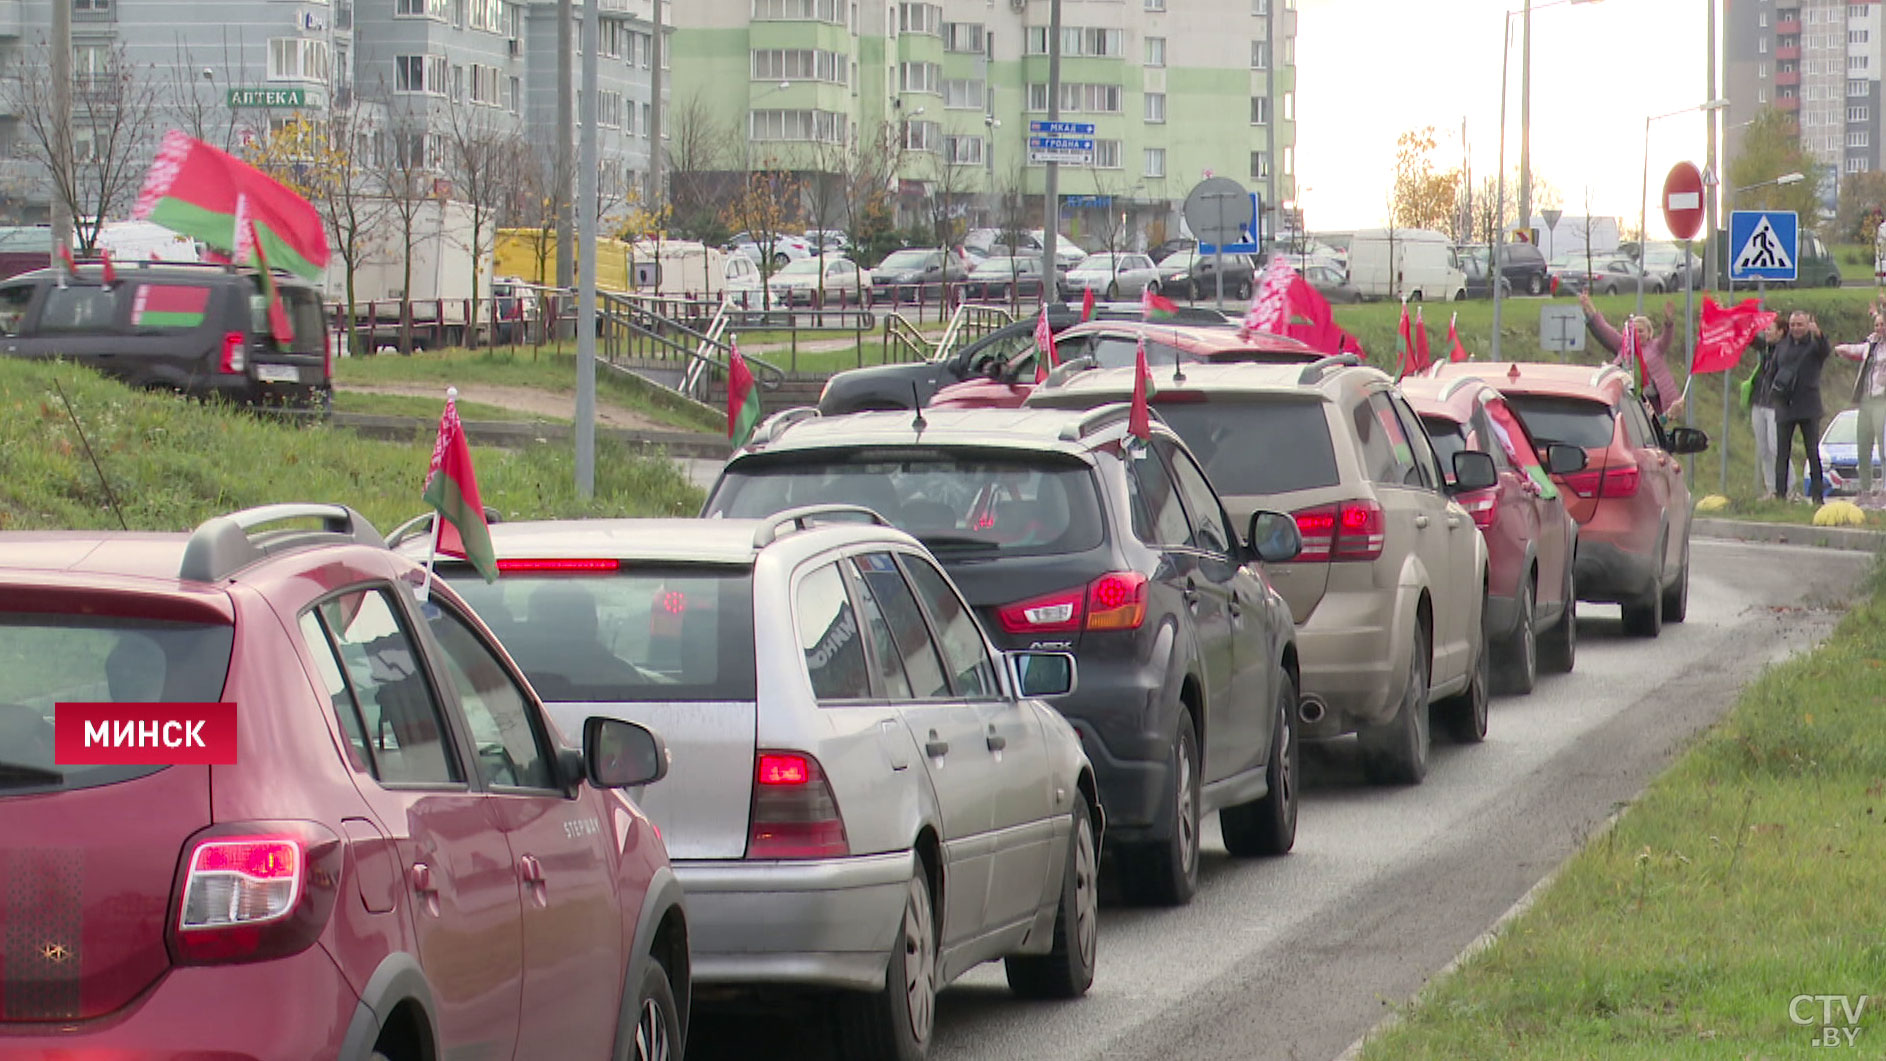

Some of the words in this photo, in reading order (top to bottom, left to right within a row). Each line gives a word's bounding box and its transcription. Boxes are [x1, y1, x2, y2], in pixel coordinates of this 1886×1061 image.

[232, 91, 298, 105] АПТЕКА
[1050, 123, 1077, 133] МКАД
[563, 818, 600, 838] STEPWAY
